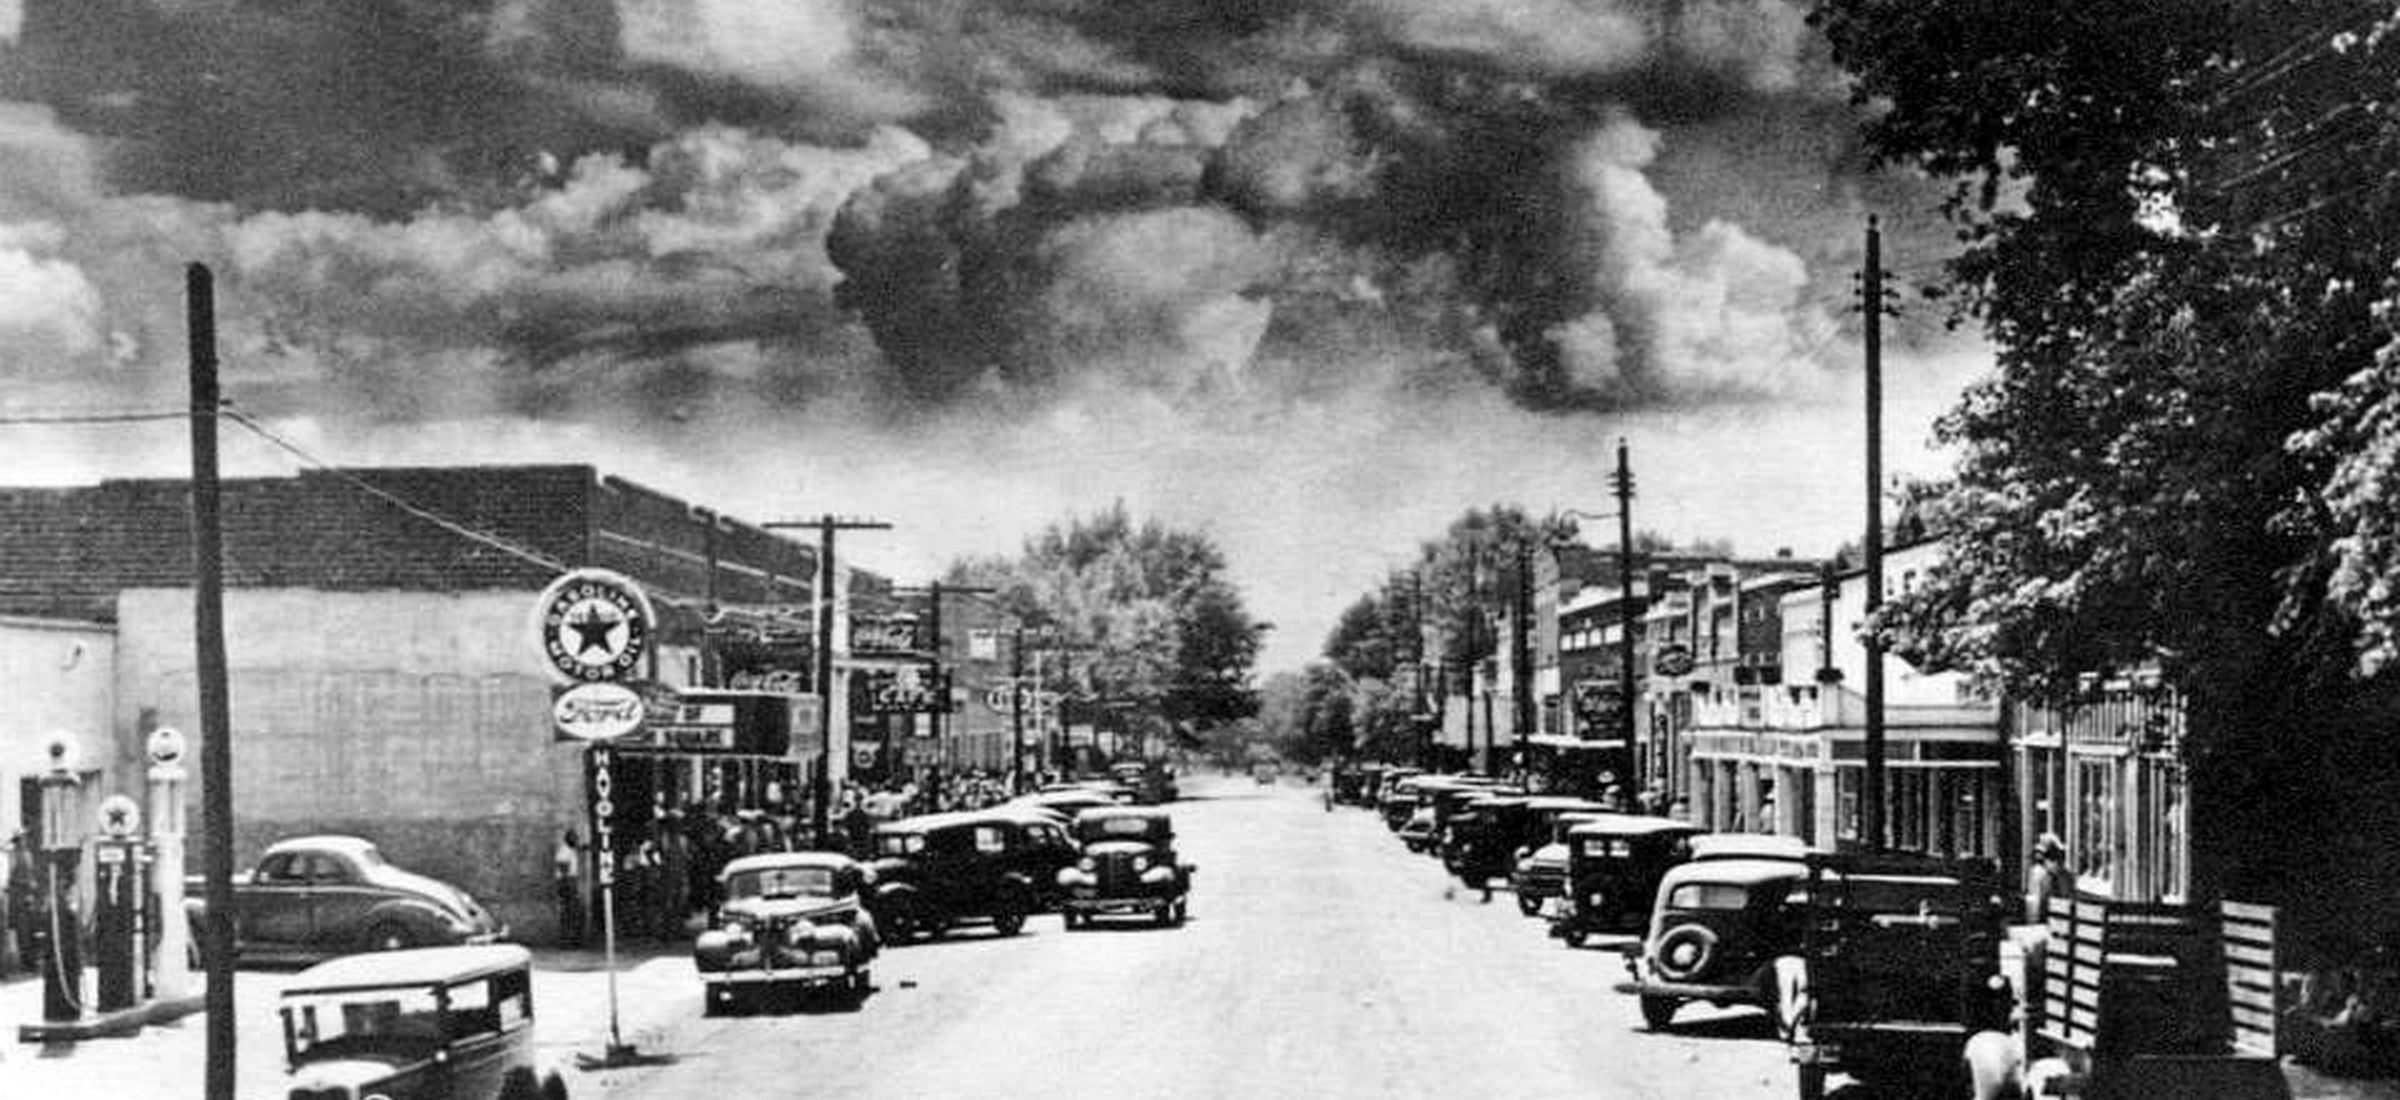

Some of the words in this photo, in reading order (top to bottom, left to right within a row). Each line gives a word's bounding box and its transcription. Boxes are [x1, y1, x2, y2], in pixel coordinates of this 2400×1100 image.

[548, 582, 639, 627] GASOLINE
[549, 639, 616, 681] MOTOR
[618, 636, 642, 668] OIL
[559, 698, 639, 725] Ford
[593, 750, 616, 886] HAVOLINE
